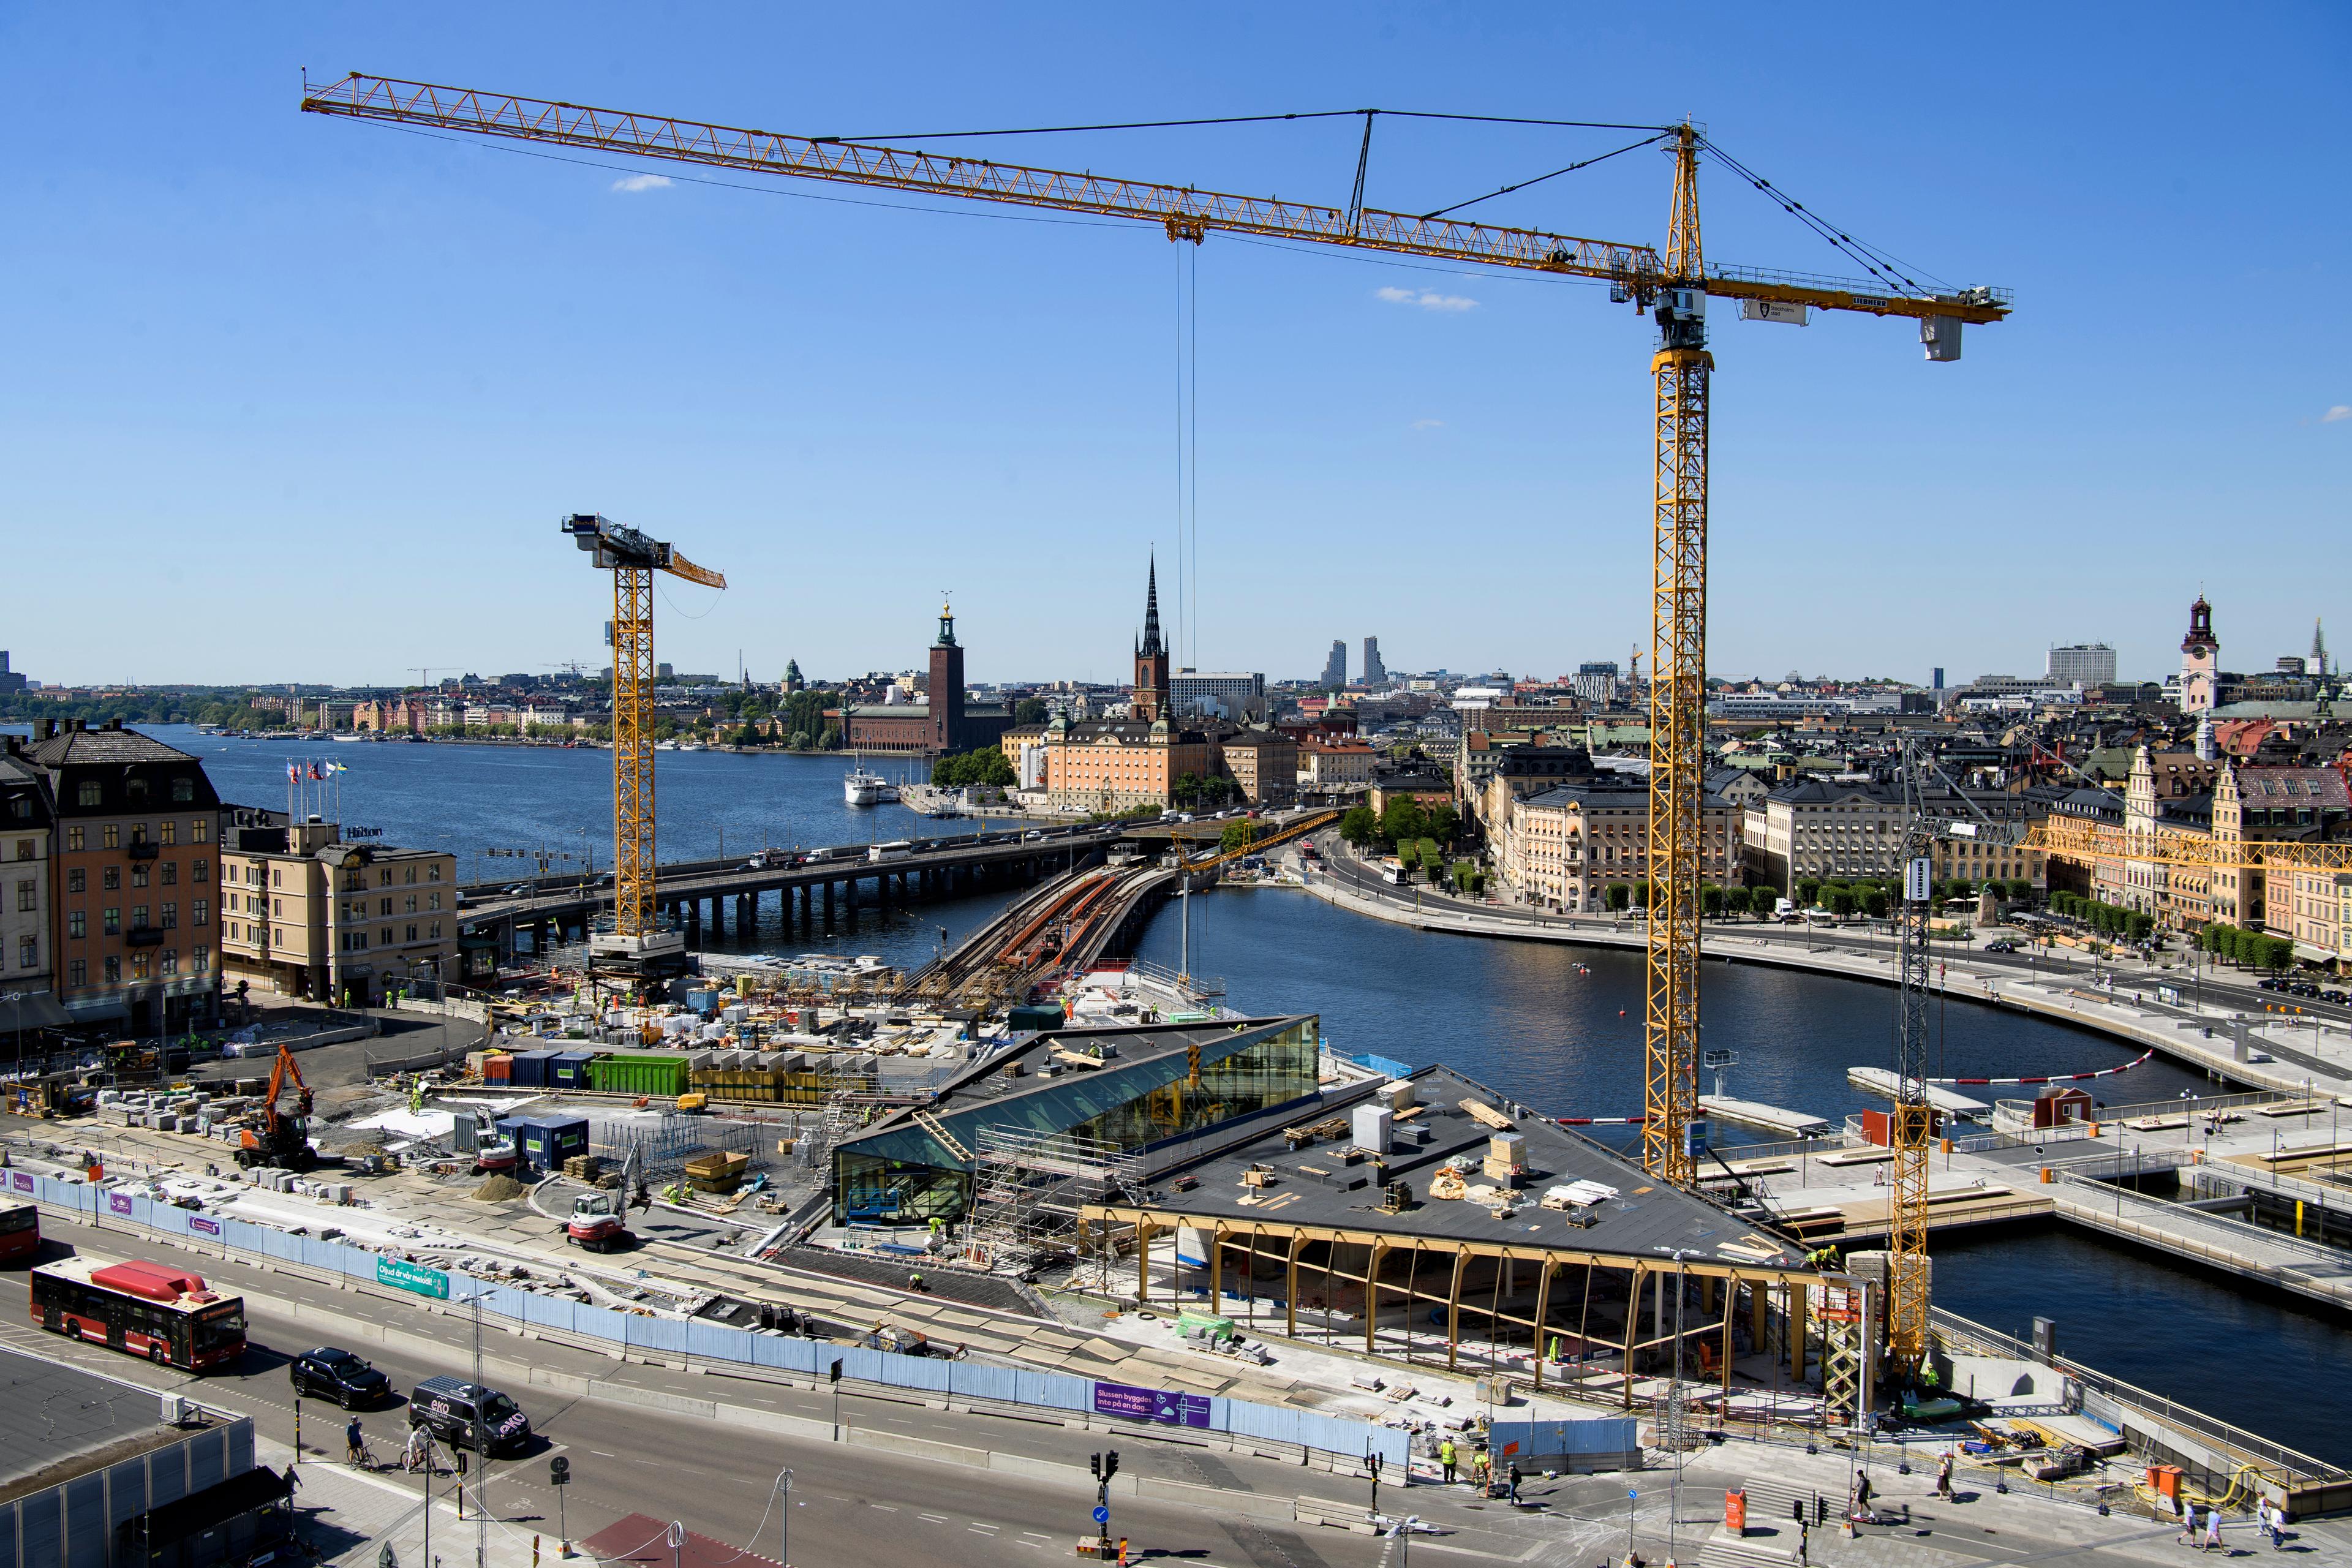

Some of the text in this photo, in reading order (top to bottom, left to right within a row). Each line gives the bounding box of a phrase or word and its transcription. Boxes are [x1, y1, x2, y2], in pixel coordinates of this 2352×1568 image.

[1853, 298, 1886, 307] LIEBHERR
[347, 826, 382, 838] Hilton
[67, 997, 121, 1008] KONSTHANTVERKARNA
[379, 1265, 395, 1276] Oljud
[396, 1269, 402, 1278] är
[402, 1271, 413, 1281] vår
[412, 1275, 432, 1286] melodi!
[1098, 1390, 1152, 1403] Slussen byggdes
[431, 1400, 450, 1414] eko
[1112, 1400, 1121, 1408] på
[1131, 1403, 1152, 1412] dag...
[500, 1413, 526, 1434] eko
